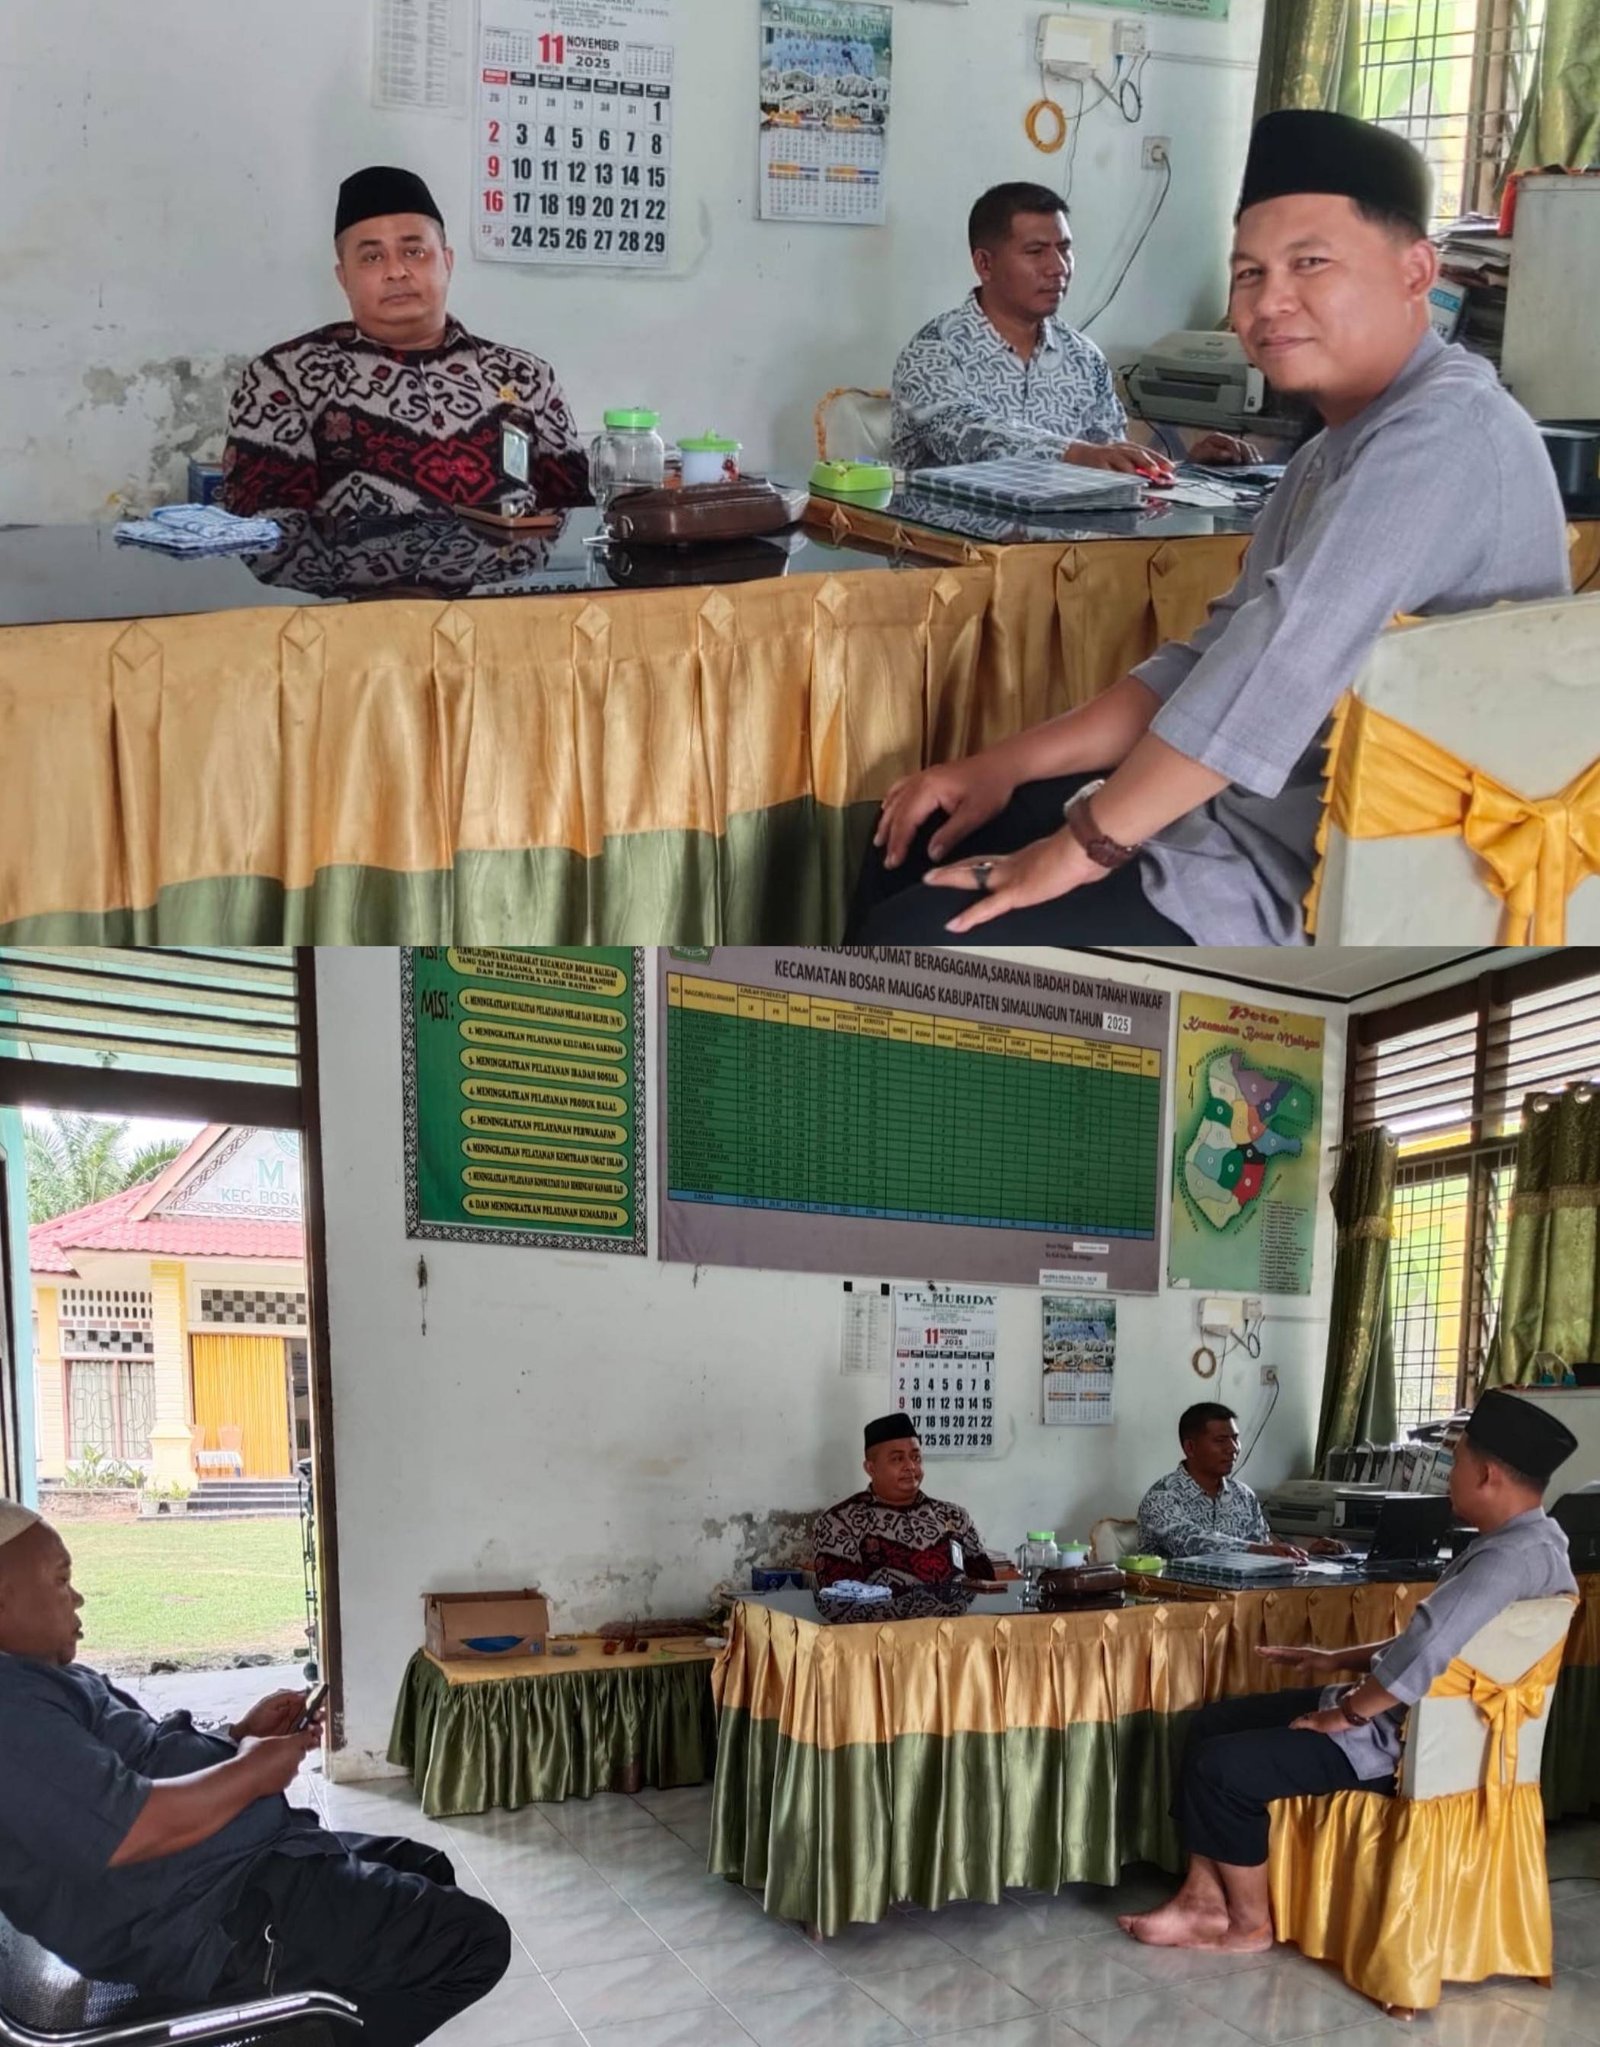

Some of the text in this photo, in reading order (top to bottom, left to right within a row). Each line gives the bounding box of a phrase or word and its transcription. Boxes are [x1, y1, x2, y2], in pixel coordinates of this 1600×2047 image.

[538, 33, 564, 64] 11
[566, 35, 619, 51] NOVEMBER
[575, 56, 611, 69] 2025
[653, 101, 661, 121] 1
[488, 121, 662, 155] 2 3 4 5 6 7 8
[488, 155, 665, 188] 9 10 11 12 13 14 15
[483, 190, 666, 220] 16 17 18 19 20 21 22
[511, 226, 665, 252] 24 25 26 27 28 29
[775, 959, 1129, 1032] KECAMATAN BOSAR MALIGAS KABUPATEN SIMALUNGUN TAHUN 2025
[1033, 973, 1070, 994] IBADAH
[1072, 980, 1093, 999] DAN
[1096, 984, 1128, 1005] TANAH
[1130, 990, 1163, 1010] WAKAF
[257, 1159, 285, 1190] M
[924, 1328, 939, 1345] 11
[986, 1361, 990, 1372] 1
[899, 1378, 990, 1391] 2 3 4 5 6 7 8
[898, 1397, 992, 1409] 9 10 11 12 13 14 15
[926, 1416, 936, 1428] 18
[940, 1416, 950, 1428] 19
[953, 1416, 965, 1428] 20
[968, 1416, 978, 1428] 21
[981, 1416, 992, 1428] 22
[925, 1434, 937, 1446] 25
[939, 1434, 951, 1446] 26
[954, 1434, 964, 1446] 27
[967, 1434, 978, 1446] 28
[981, 1434, 992, 1446] 29
